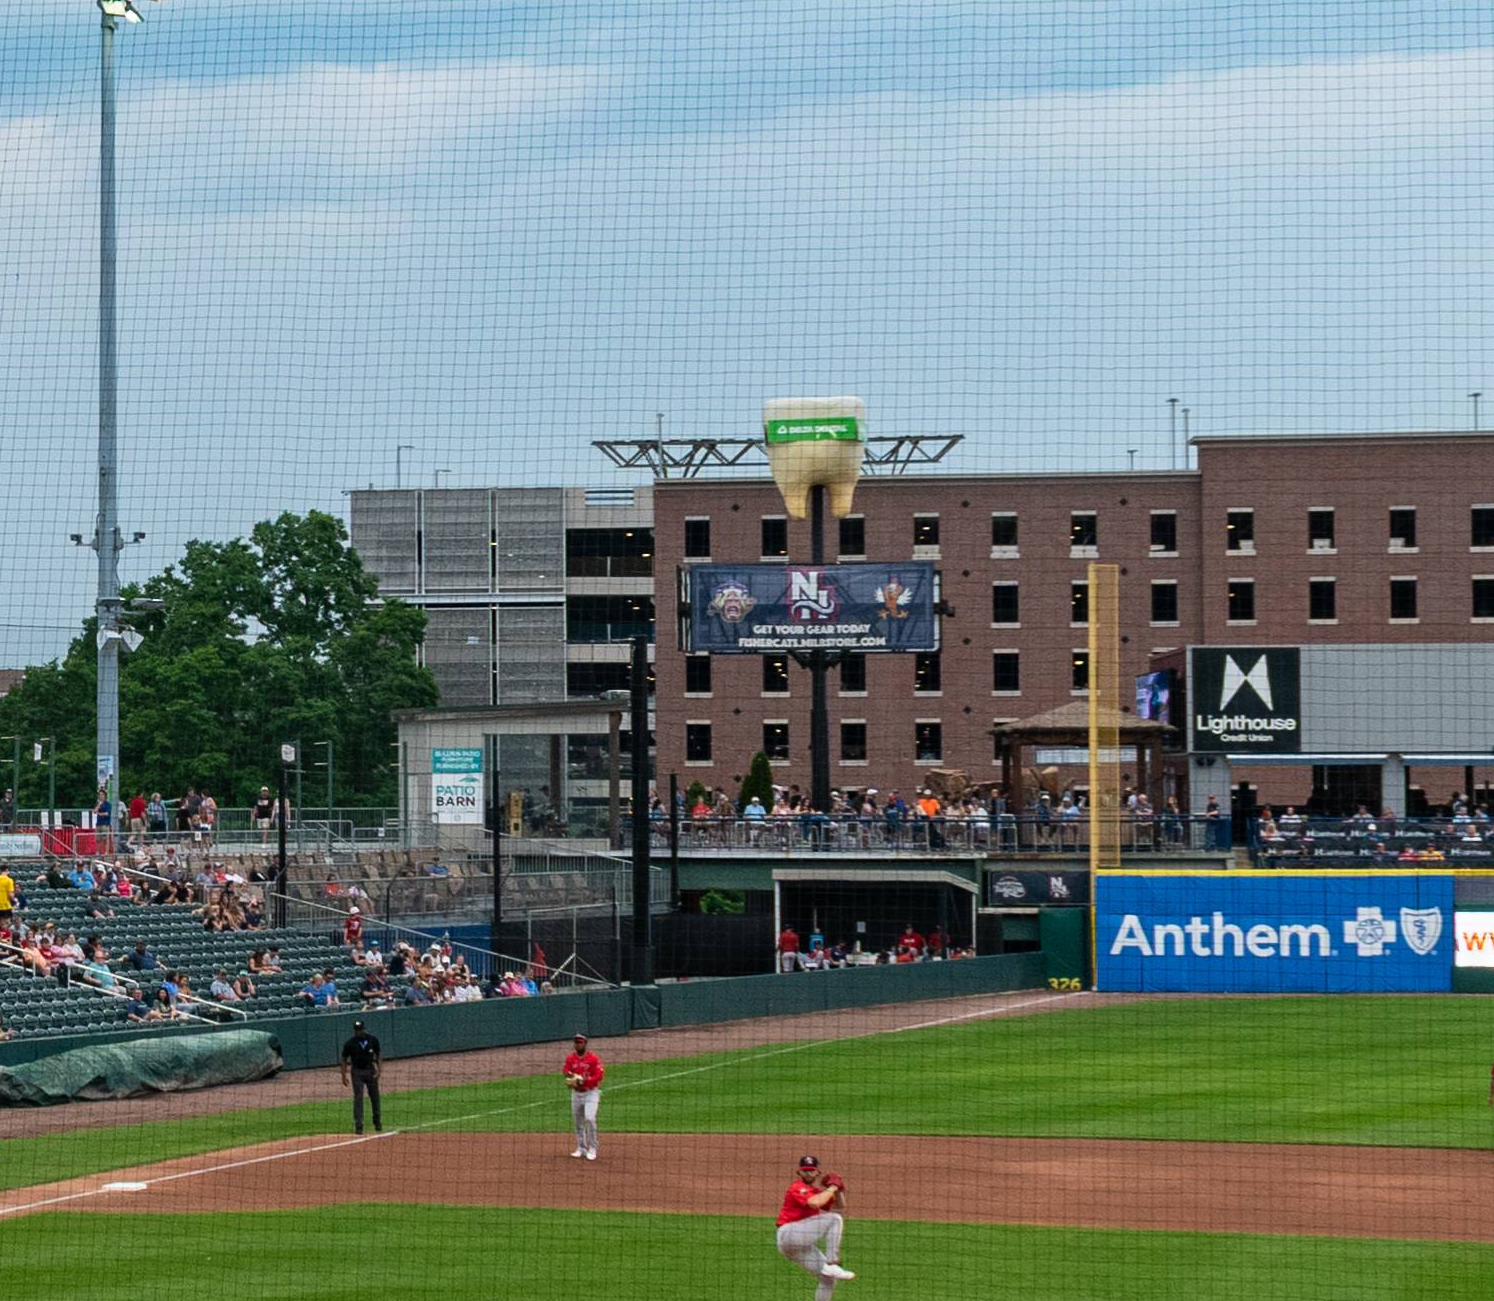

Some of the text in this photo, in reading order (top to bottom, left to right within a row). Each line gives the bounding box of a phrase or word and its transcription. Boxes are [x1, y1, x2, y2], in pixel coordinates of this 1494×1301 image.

[753, 624, 871, 634] GET YOUR GEAR TODAY
[1196, 714, 1297, 735] Lighthouse
[1248, 733, 1274, 742] Union
[436, 785, 475, 796] PATIO
[436, 796, 475, 807] BARN
[1110, 912, 1331, 957] Anthem
[1048, 976, 1083, 990] 326
